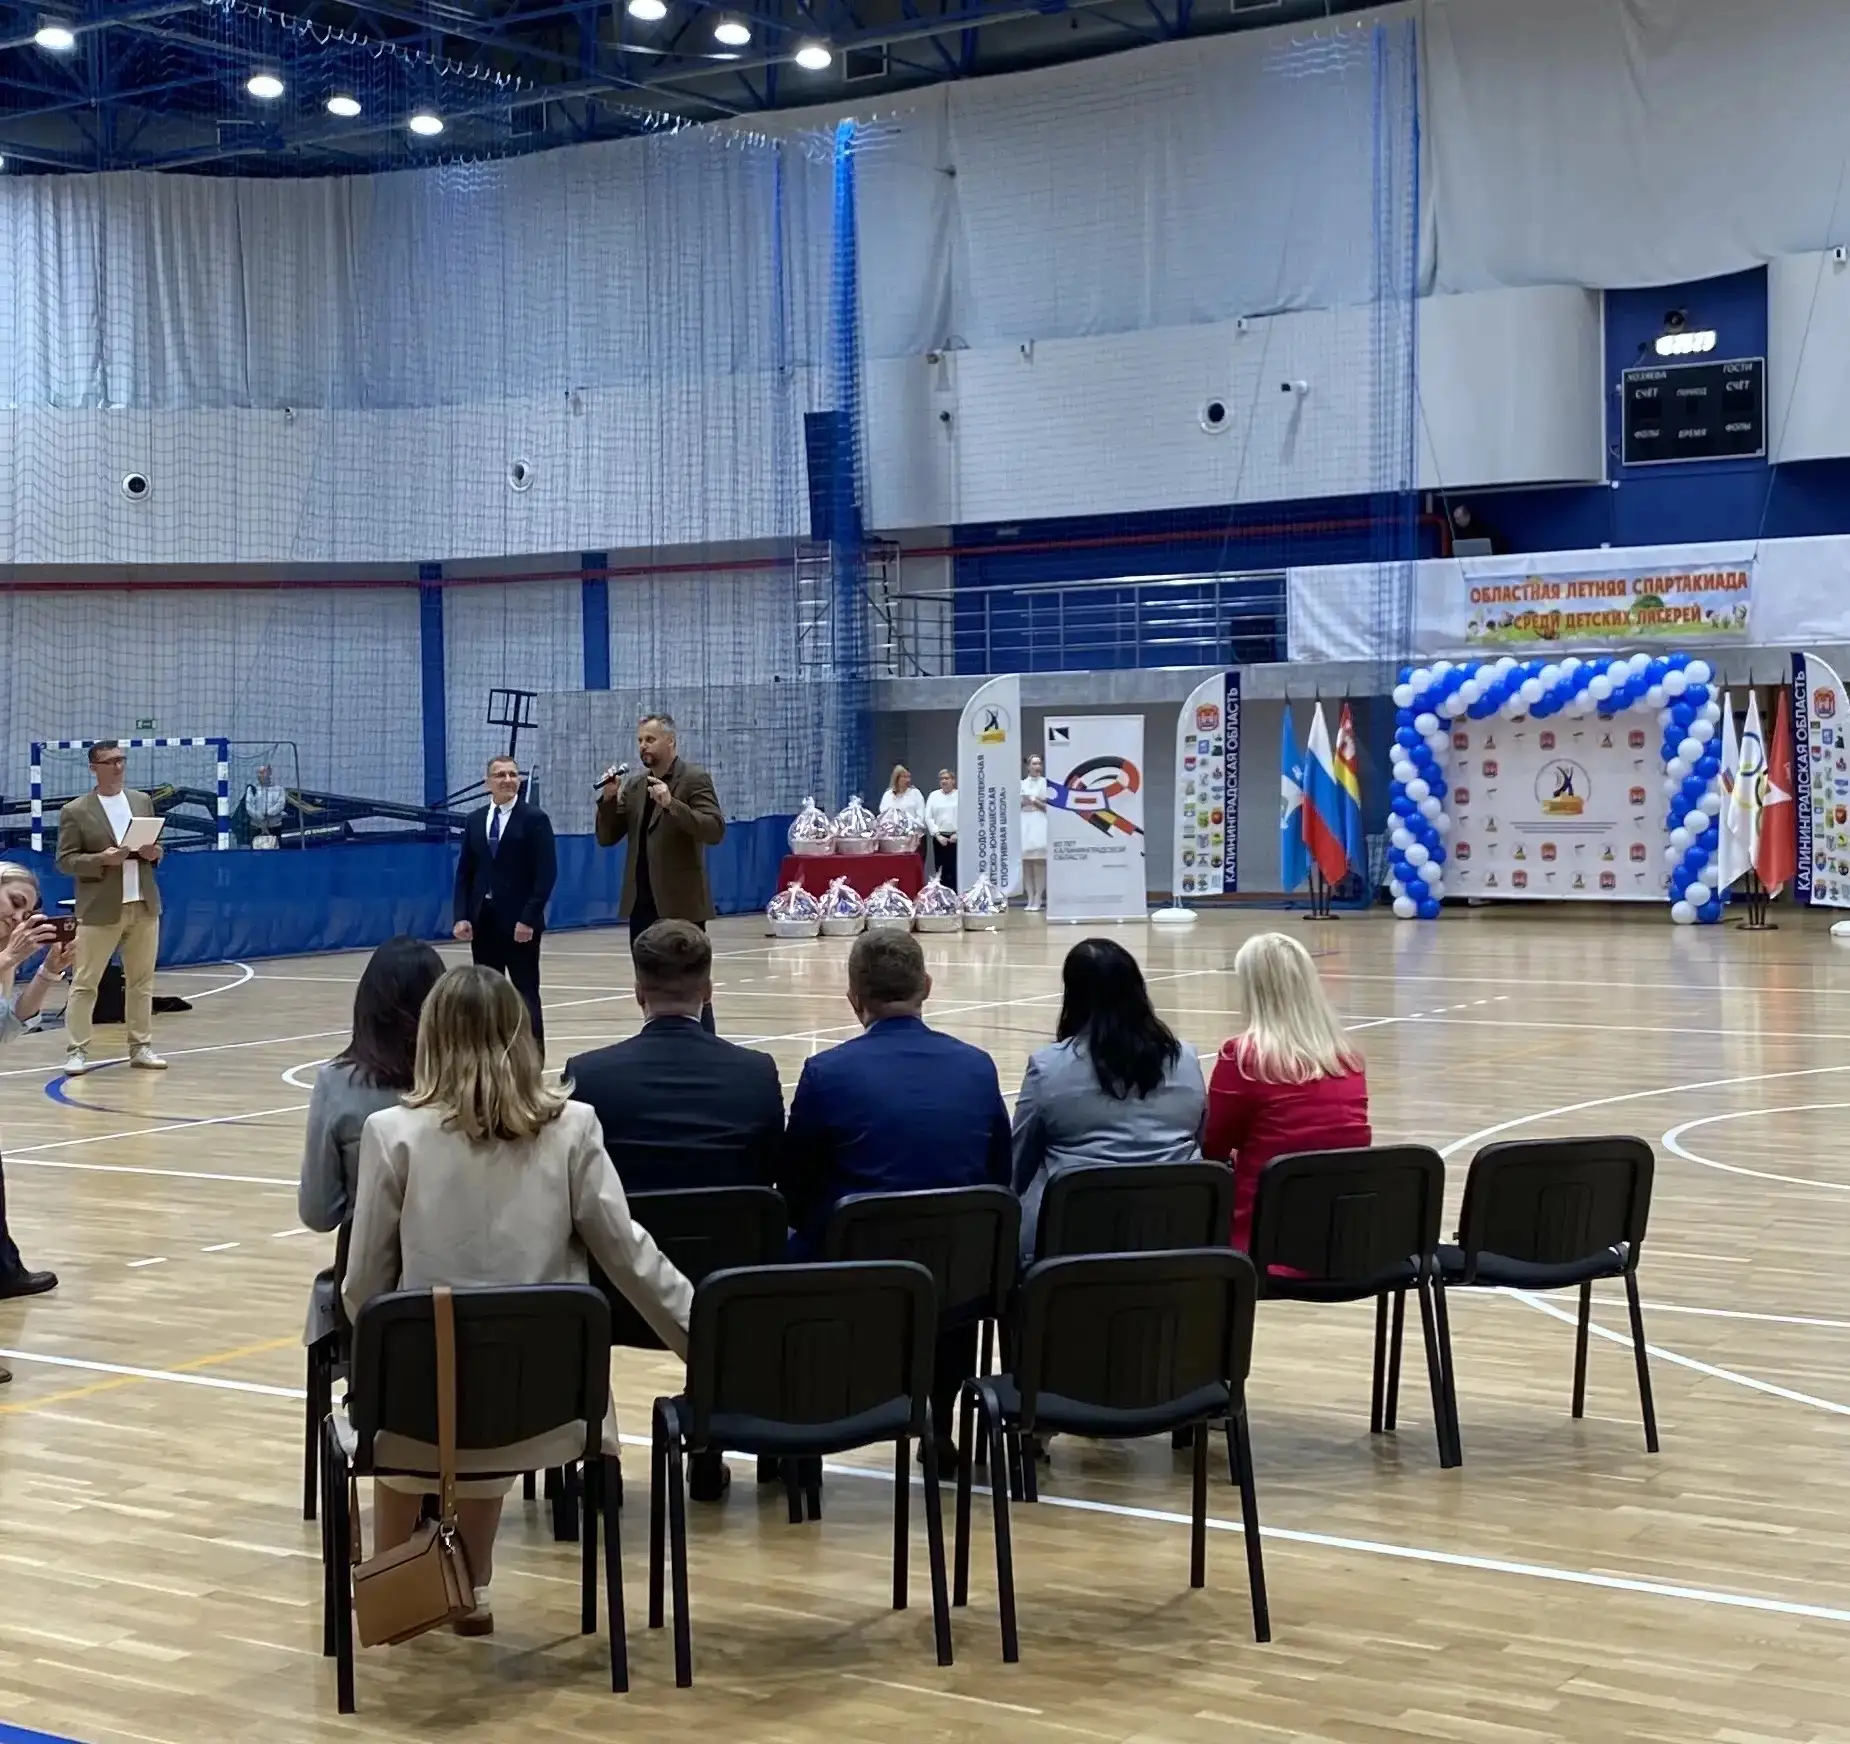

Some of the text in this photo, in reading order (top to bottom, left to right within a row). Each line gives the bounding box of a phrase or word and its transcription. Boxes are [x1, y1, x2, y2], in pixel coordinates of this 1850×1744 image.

[1470, 571, 1748, 604] ОБЛАСТНАЯ ЛЕТНЯЯ СПАРТАКИАДА
[1514, 613, 1560, 631] СРЕДИ
[1565, 610, 1631, 631] ДЕТСКИХ
[1224, 687, 1239, 883] КАЛИНИНГРАДСКАЯ ОБЛАСТЬ
[1795, 670, 1812, 891] КАЛИНИНГРАДСКАЯ ОБЛАСТЬ
[978, 860, 988, 873] КО
[999, 827, 1009, 888] СПОРТИВНАЯ
